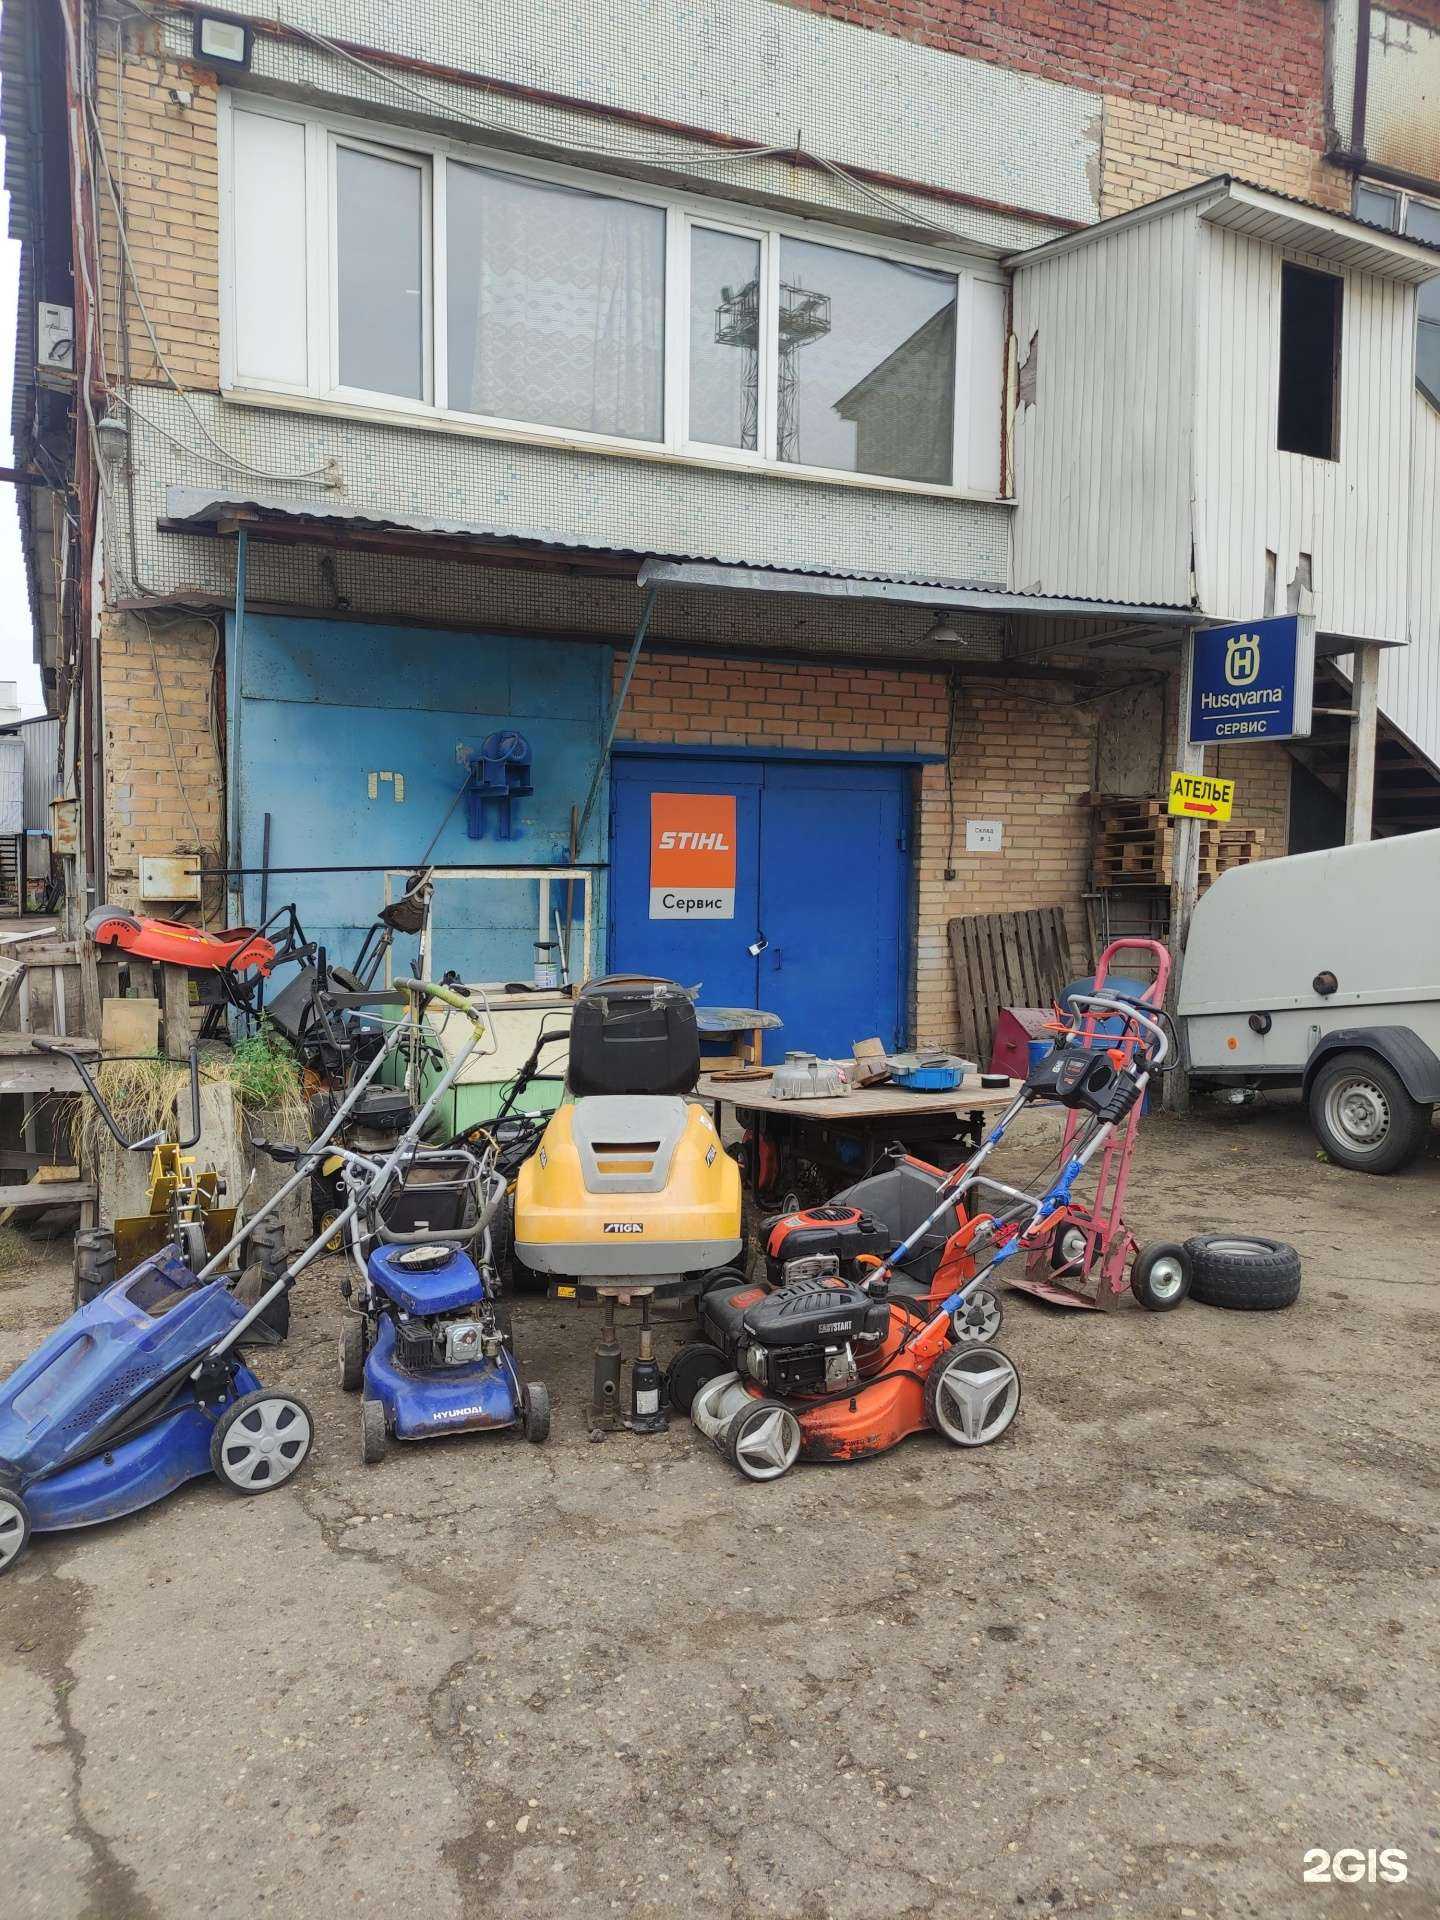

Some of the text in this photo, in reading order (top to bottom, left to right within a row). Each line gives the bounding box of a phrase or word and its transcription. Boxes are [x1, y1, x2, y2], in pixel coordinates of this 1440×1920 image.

[1201, 688, 1282, 709] Husqvarna
[1215, 720, 1267, 735] СЕРВИС
[1173, 778, 1231, 802] АТЕЛЬЕ
[659, 831, 729, 851] STIHL
[662, 893, 722, 912] Сервис
[604, 1223, 643, 1233] STIGA
[433, 1406, 482, 1420] HYUNDAI
